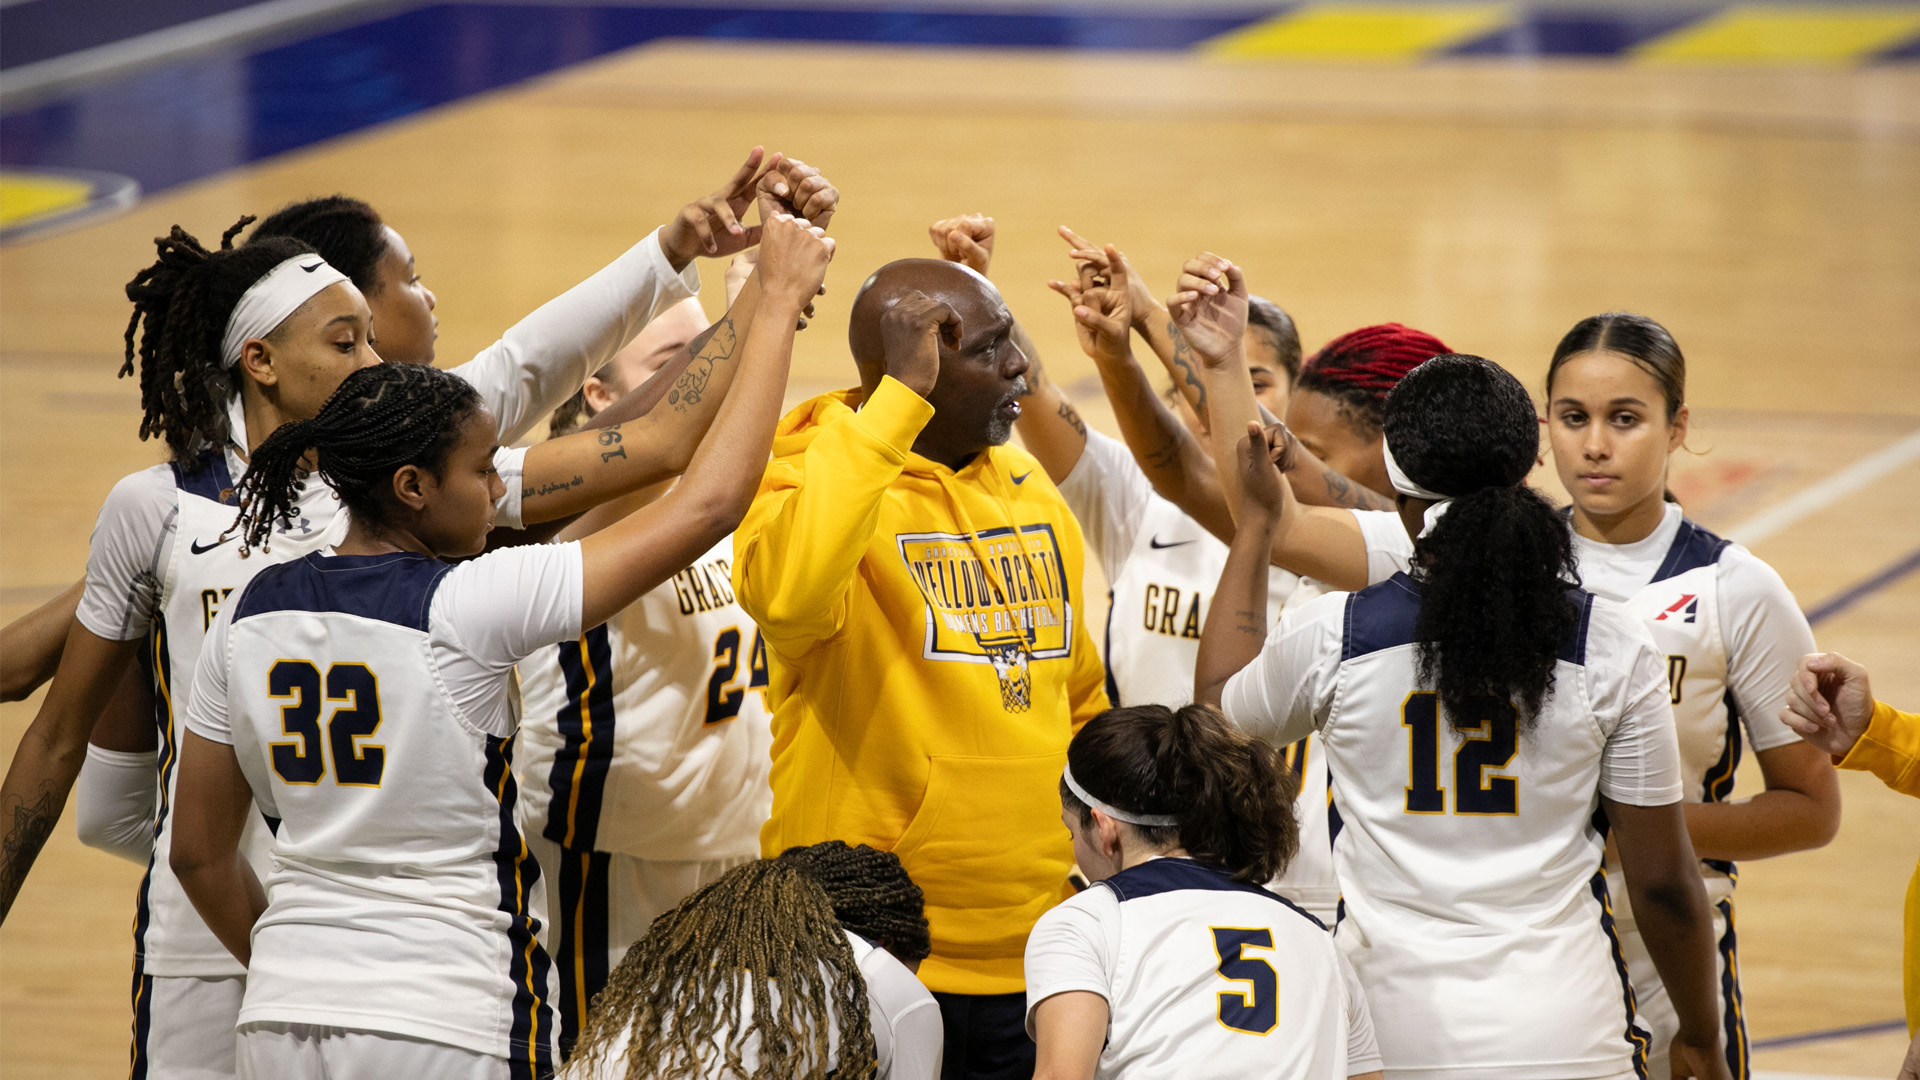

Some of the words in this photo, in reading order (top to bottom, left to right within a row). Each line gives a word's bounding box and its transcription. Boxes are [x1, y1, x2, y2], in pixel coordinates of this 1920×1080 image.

[598, 424, 627, 463] 19
[201, 588, 234, 635] G
[1143, 583, 1206, 641] GRA
[267, 658, 386, 788] 32
[1400, 691, 1519, 816] 12
[1208, 925, 1279, 1037] 5
